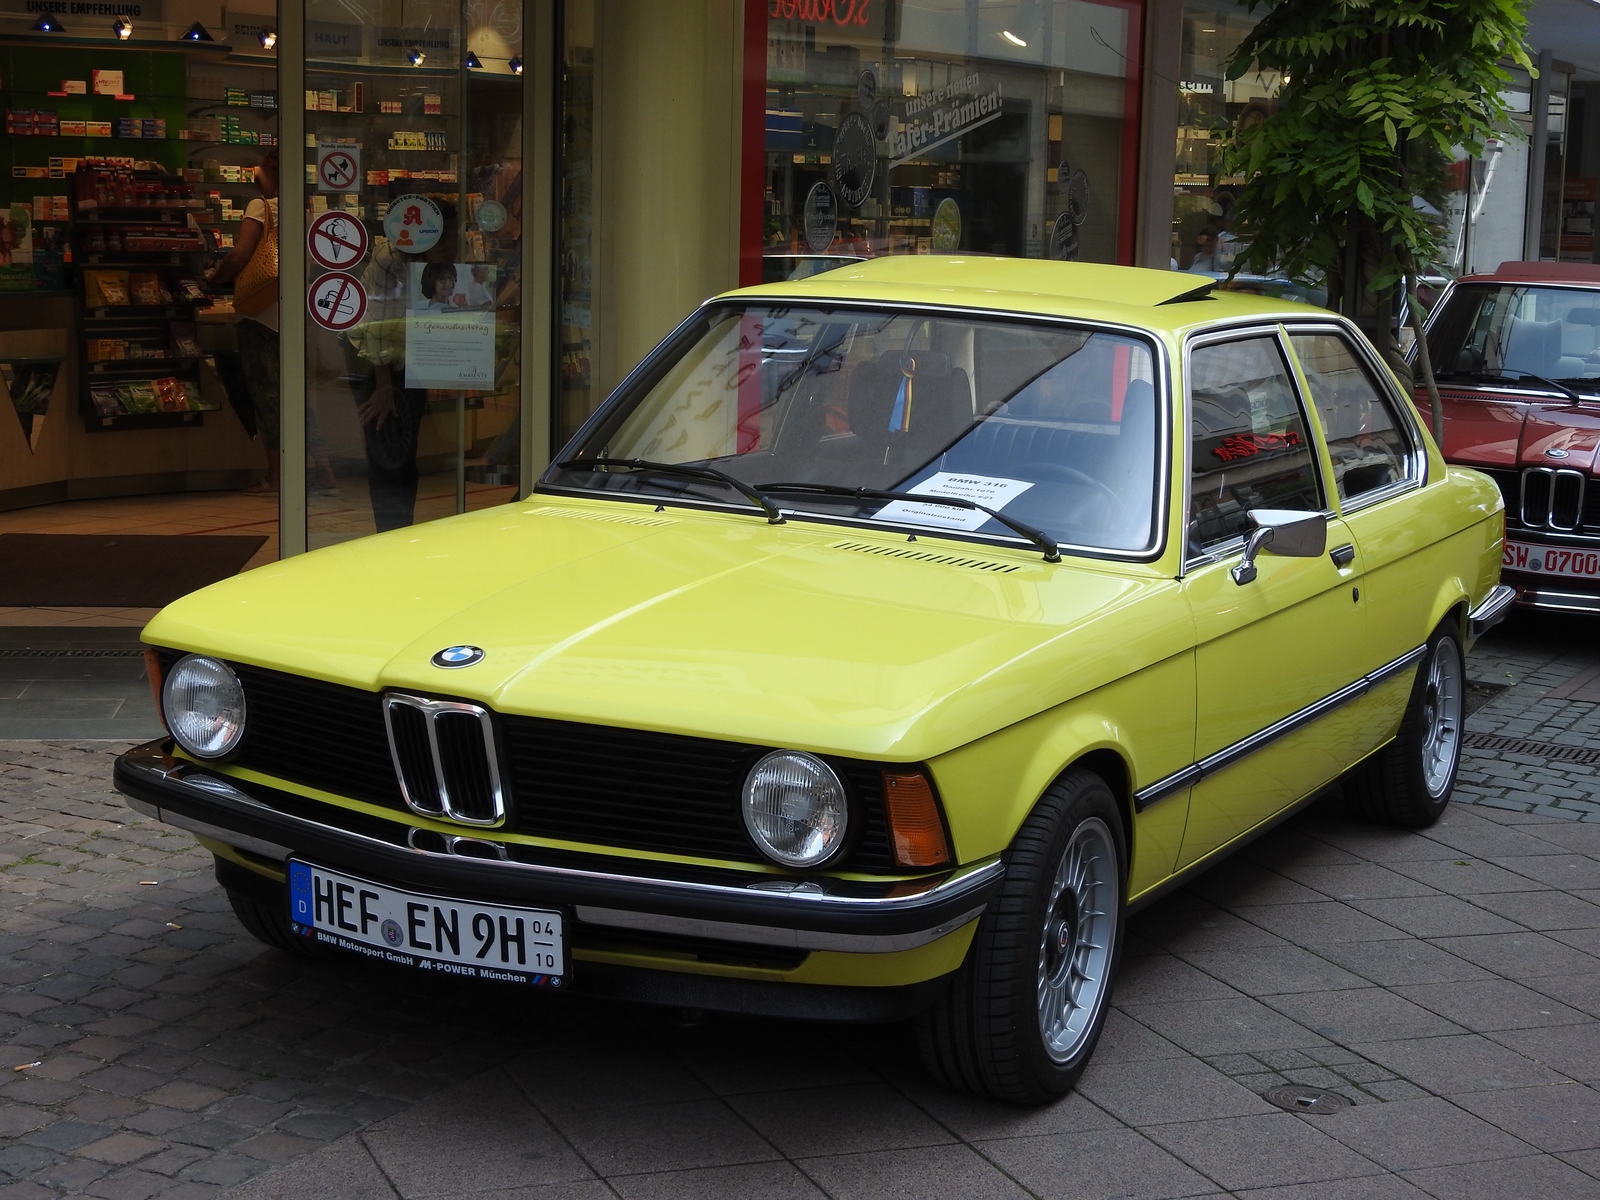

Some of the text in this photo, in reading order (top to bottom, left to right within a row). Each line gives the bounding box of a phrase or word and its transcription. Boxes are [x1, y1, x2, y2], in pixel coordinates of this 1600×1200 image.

[27, 1, 141, 17] UNSERE EMPFEHLUNG
[314, 32, 349, 46] HAUT
[905, 90, 945, 116] unsere
[946, 71, 980, 99] neuen
[386, 195, 441, 216] DIABETES-PARTNER
[424, 320, 489, 336] Gesundheitstag
[983, 481, 1009, 489] 316
[929, 489, 976, 498] Modellreihe
[902, 508, 967, 523] Originalzustand
[1502, 544, 1600, 575] SW 0700
[298, 899, 307, 914] D
[313, 875, 527, 965] HEF EN 9H
[532, 920, 554, 936] 04
[317, 931, 527, 983] BMW Motorsport GmbH M-POWER München
[535, 953, 555, 968] 10
